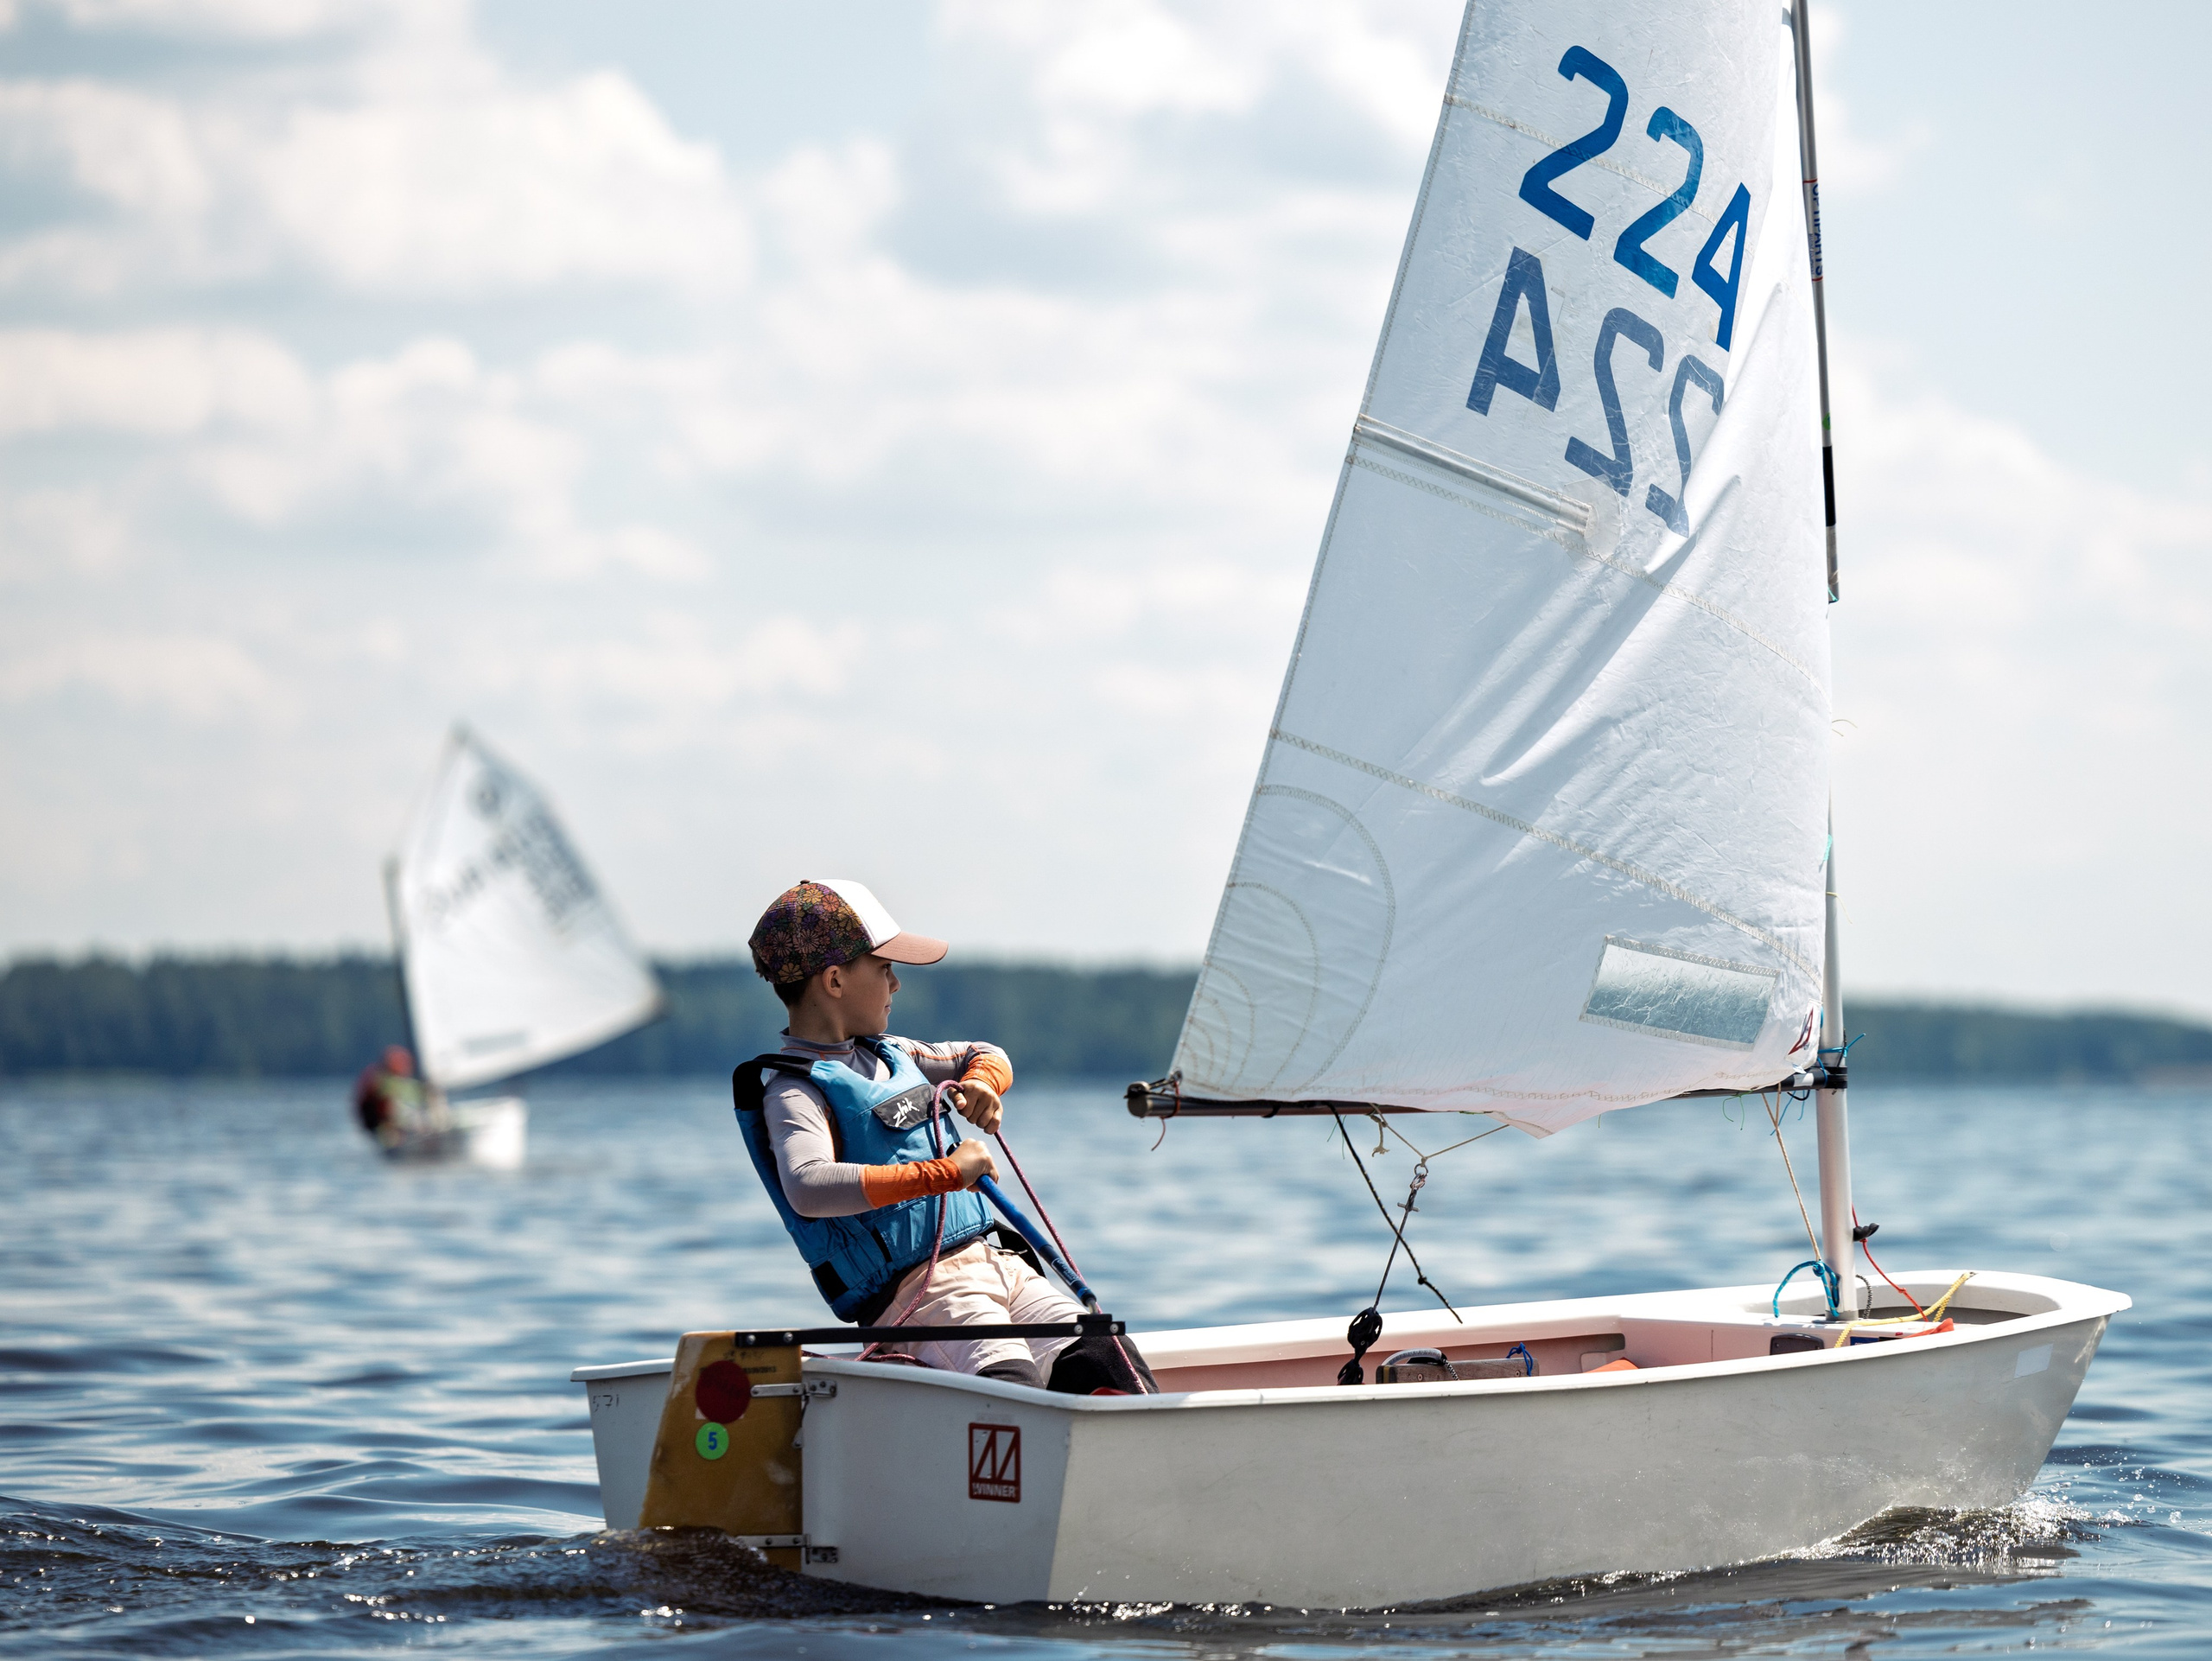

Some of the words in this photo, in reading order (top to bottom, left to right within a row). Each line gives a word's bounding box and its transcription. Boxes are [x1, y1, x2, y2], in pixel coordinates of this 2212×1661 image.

[1518, 45, 1751, 353] 224
[708, 1431, 718, 1451] 5
[972, 1483, 1015, 1498] WINNER
